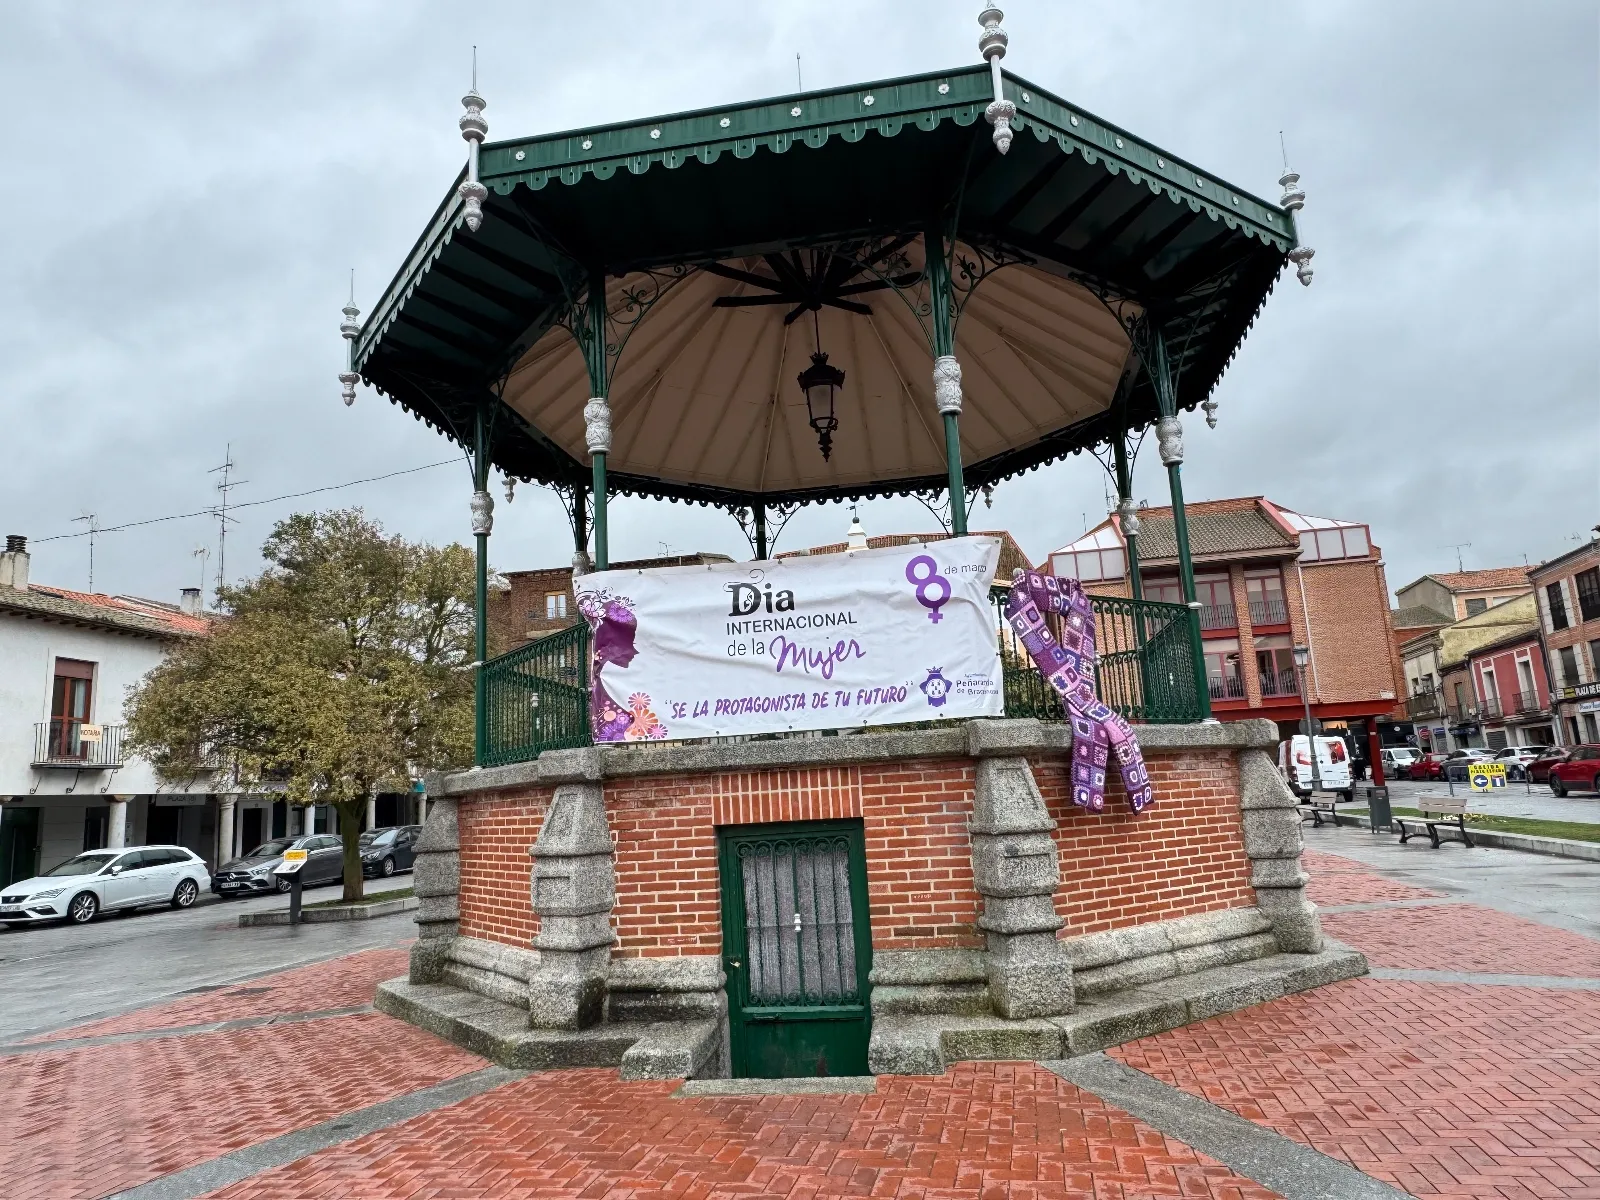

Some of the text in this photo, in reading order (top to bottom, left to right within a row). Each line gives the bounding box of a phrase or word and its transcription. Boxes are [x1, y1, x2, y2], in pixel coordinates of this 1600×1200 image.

[905, 555, 952, 611] 8
[944, 566, 958, 575] de
[726, 611, 858, 636] INTERNACIONAL
[727, 635, 867, 680] de la Mujer
[692, 700, 709, 719] LA
[714, 692, 806, 717] PROTAGONISTA
[811, 691, 830, 710] DE
[835, 690, 851, 708] TU
